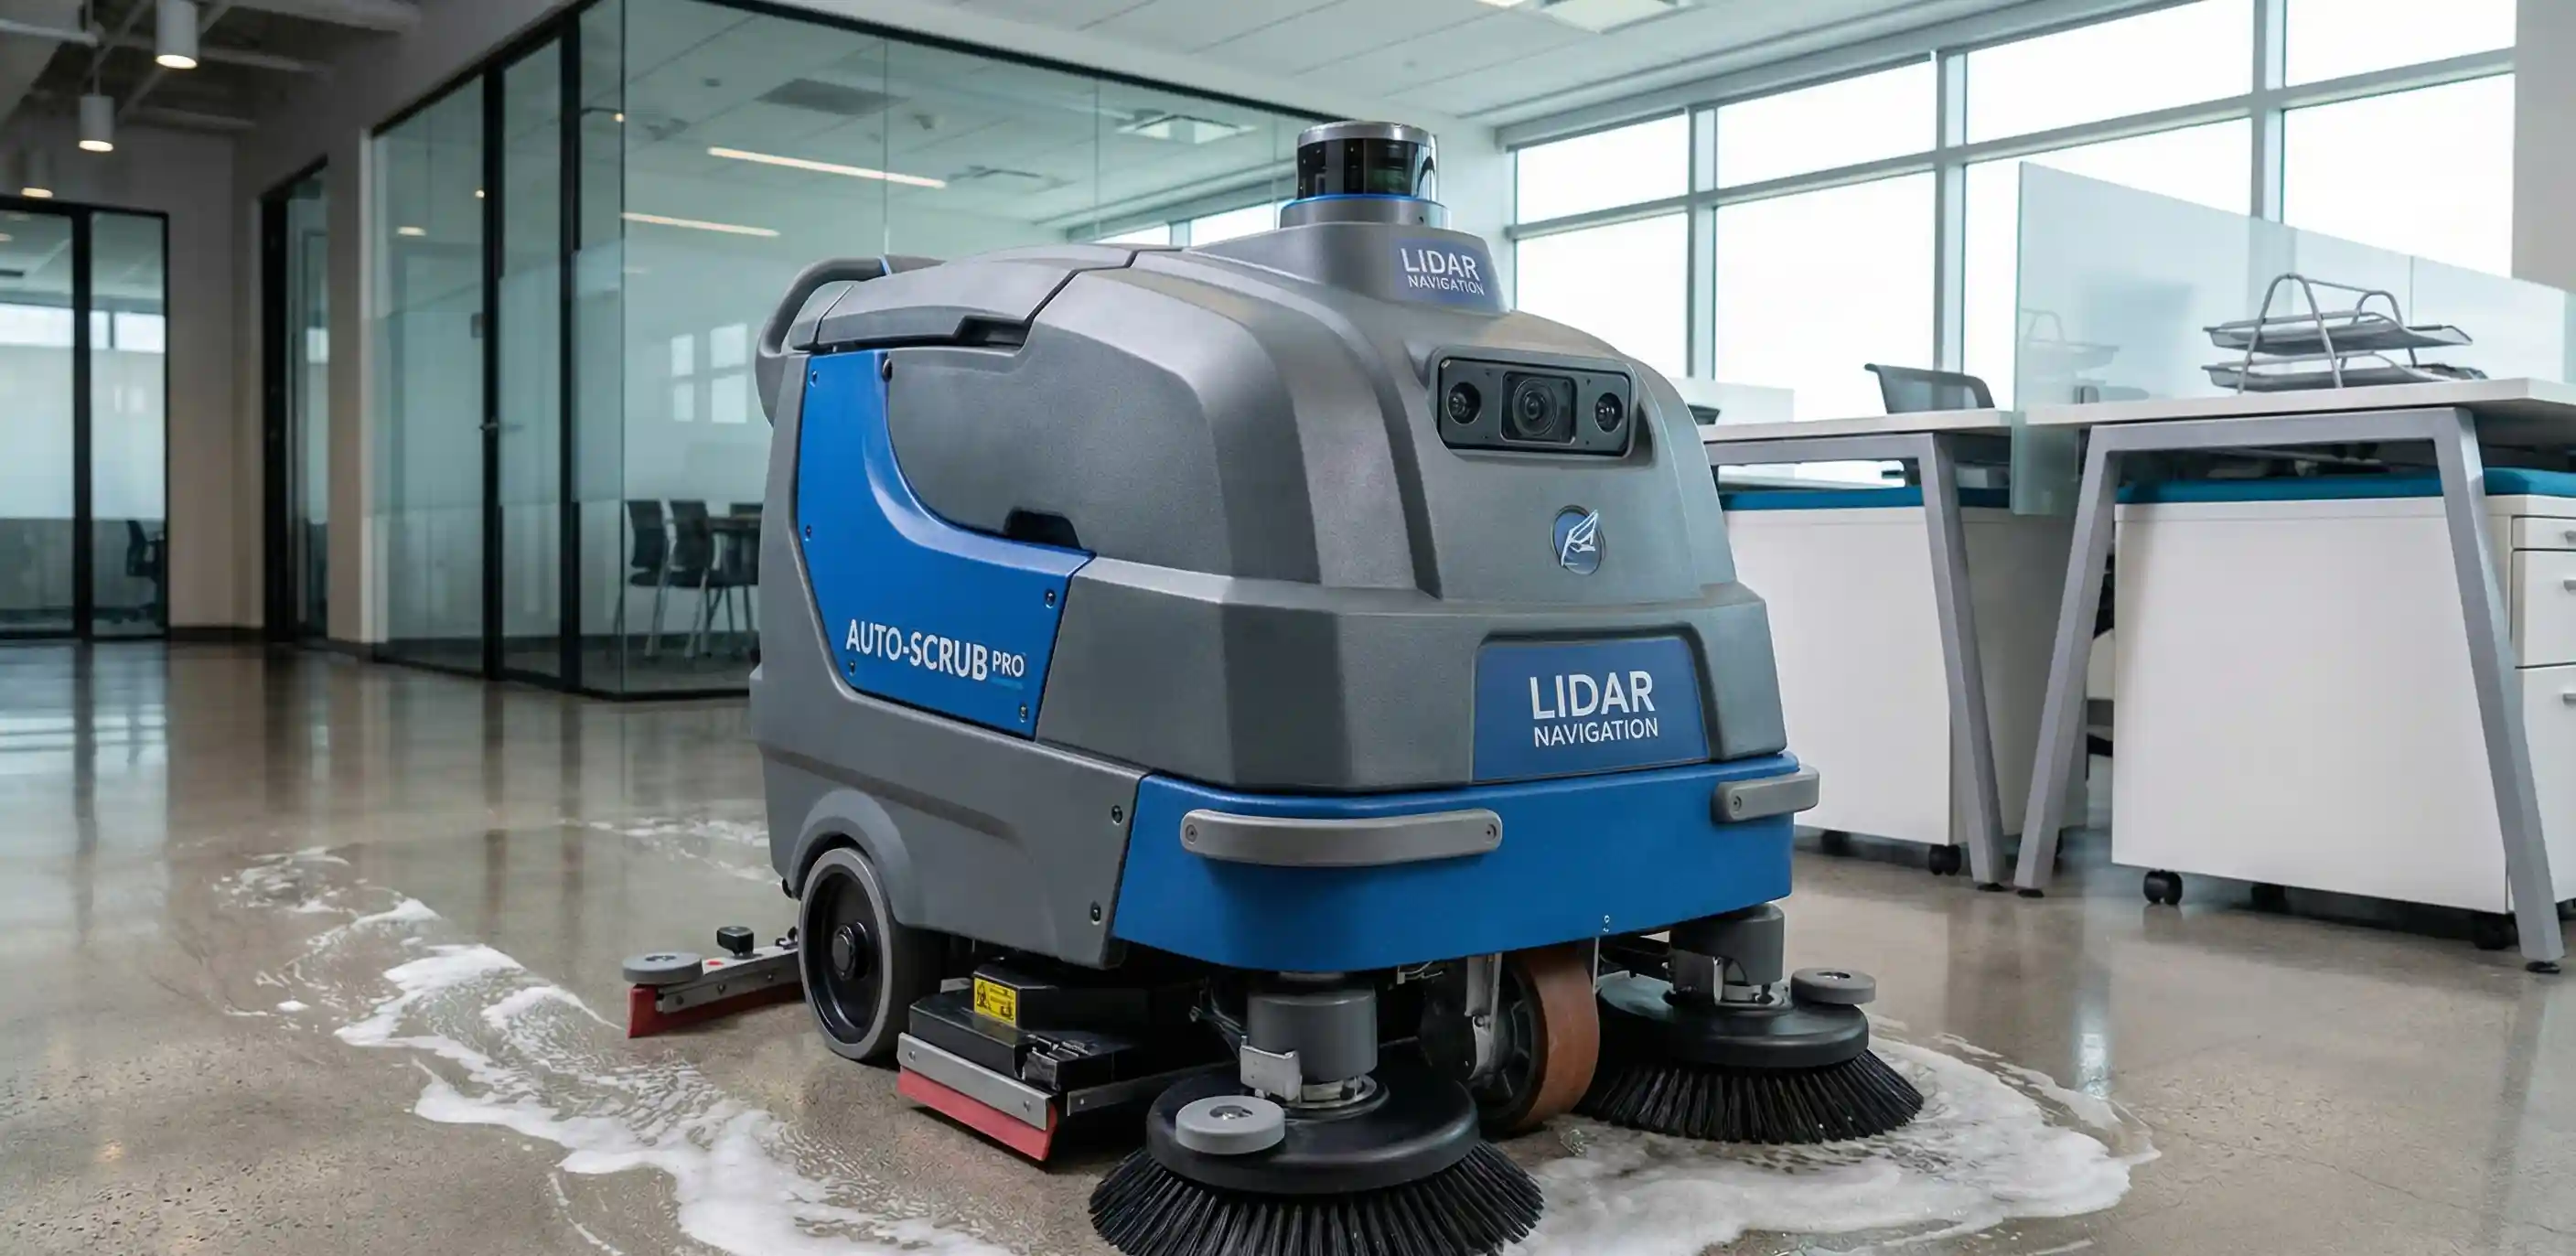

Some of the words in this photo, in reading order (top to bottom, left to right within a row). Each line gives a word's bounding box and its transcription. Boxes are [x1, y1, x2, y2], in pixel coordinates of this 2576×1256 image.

[1400, 248, 1480, 281] LIDAR
[1407, 274, 1485, 295] NAVIGATION
[845, 618, 988, 681] AUTO-SCRUB
[992, 650, 1025, 677] PRO
[1530, 671, 1656, 720] LIDAR
[1533, 717, 1658, 747] NAVIGATION
